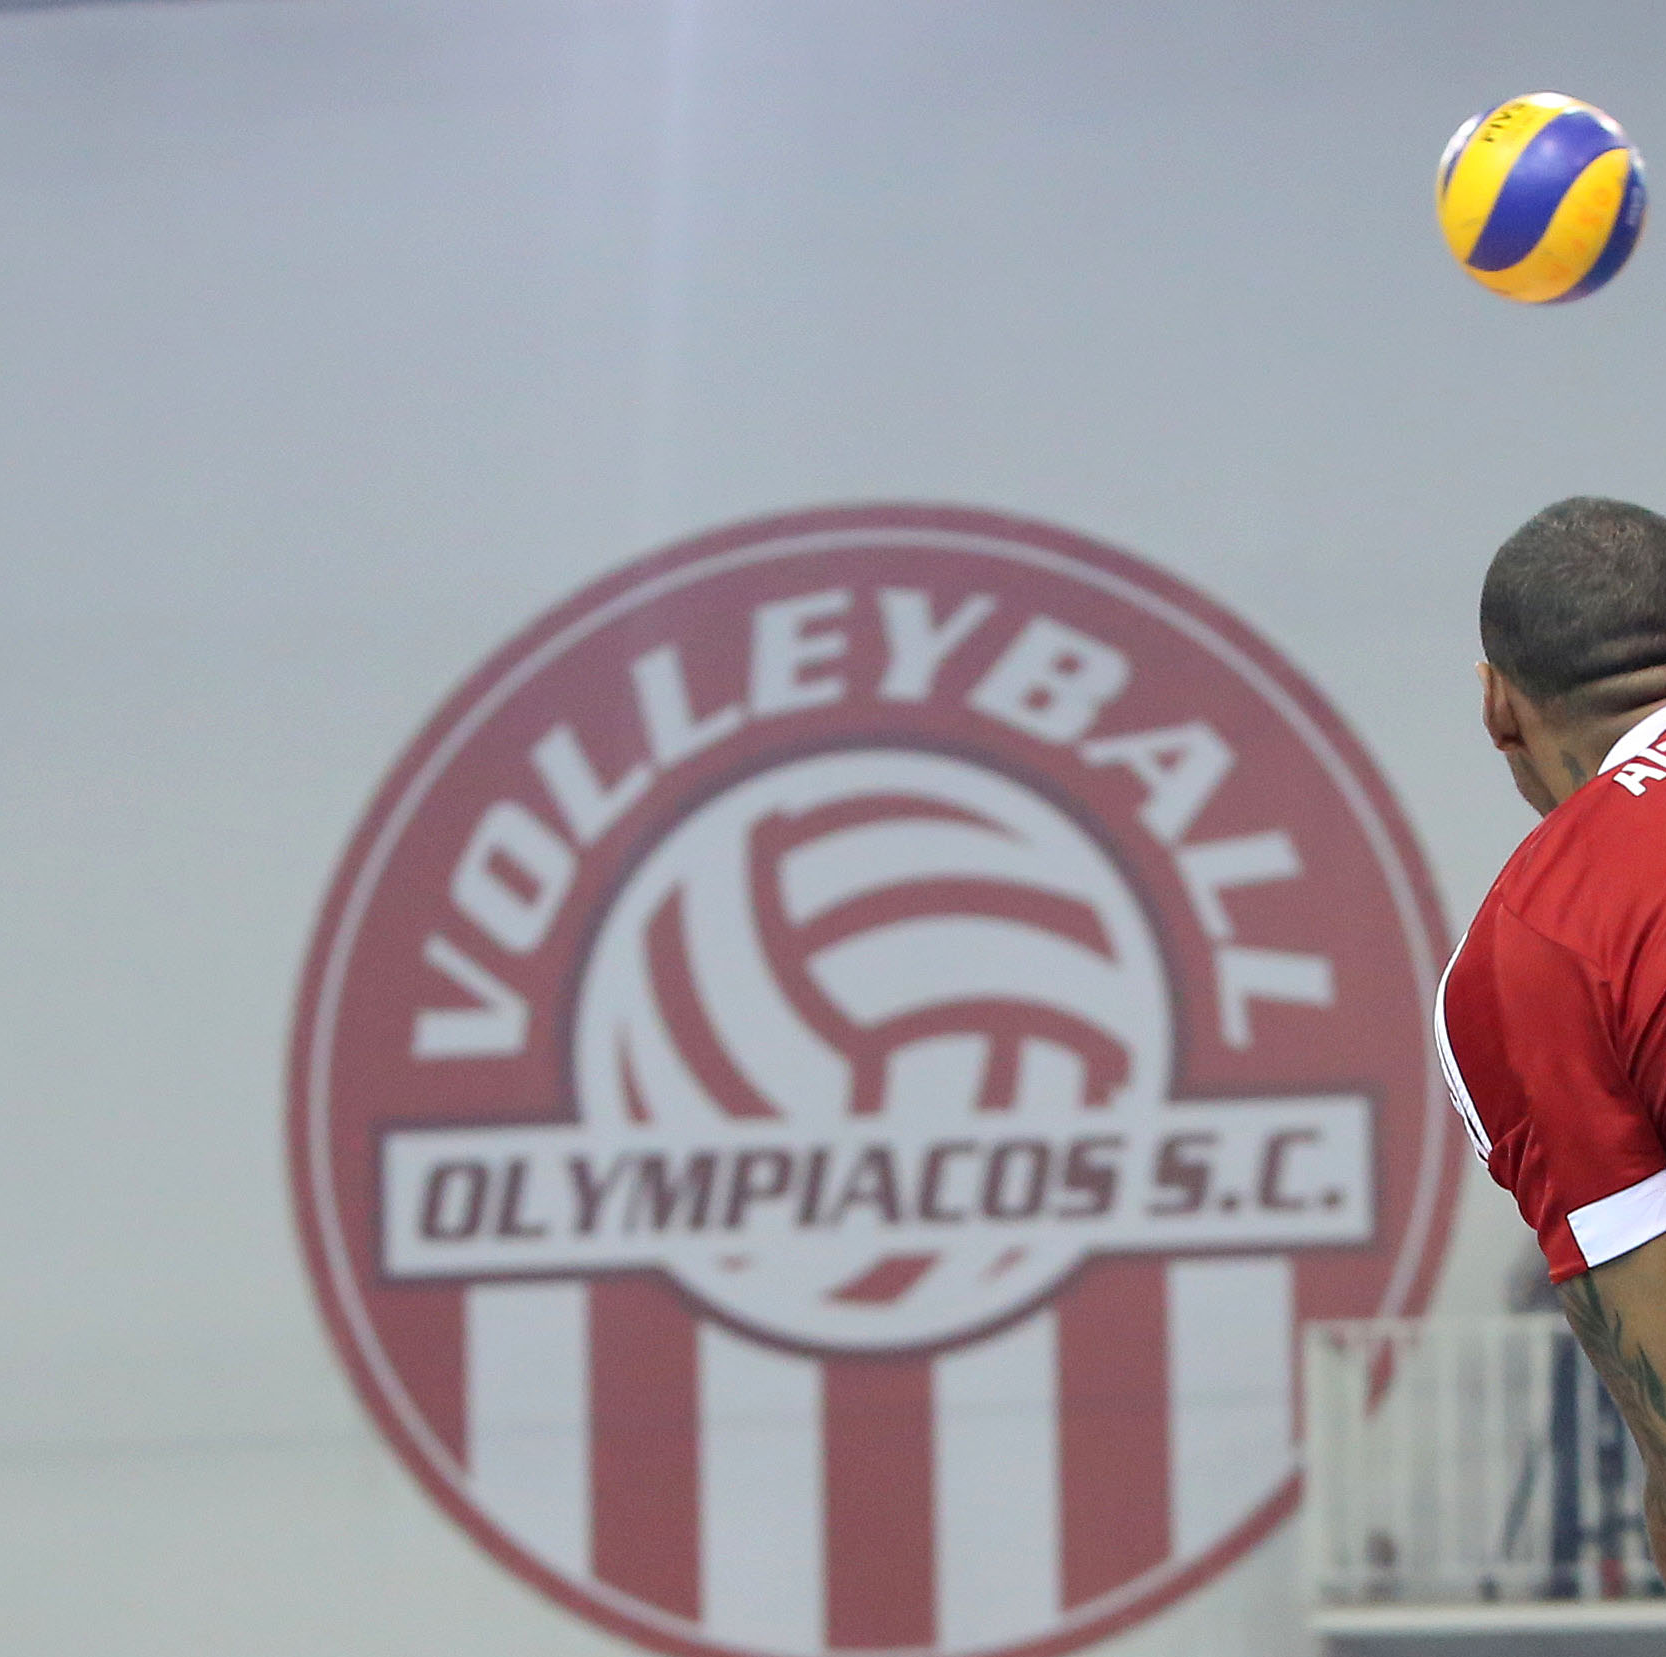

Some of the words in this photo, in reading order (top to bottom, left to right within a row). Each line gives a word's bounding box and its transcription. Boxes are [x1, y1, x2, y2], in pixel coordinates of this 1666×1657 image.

[411, 588, 1335, 1061] VOLLEYBALL
[418, 1138, 1120, 1245] OLYMPIACOS
[1147, 1127, 1347, 1219] S.C.
